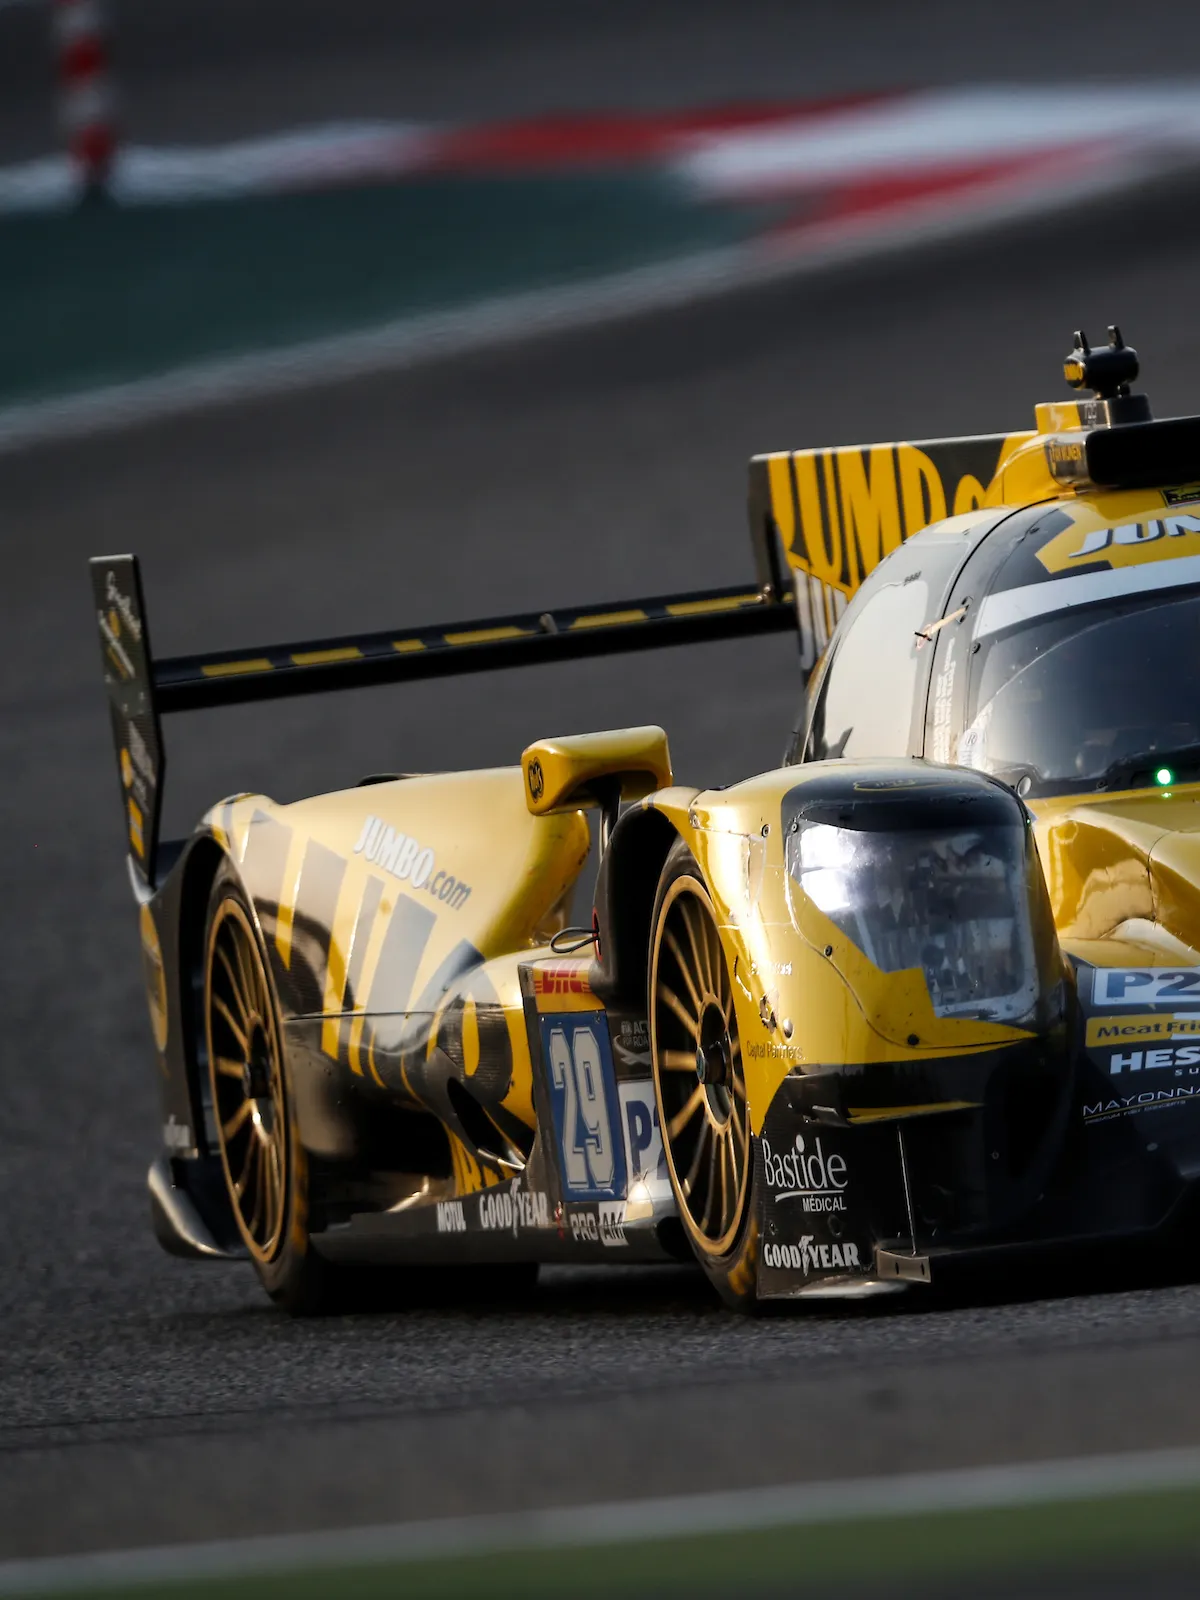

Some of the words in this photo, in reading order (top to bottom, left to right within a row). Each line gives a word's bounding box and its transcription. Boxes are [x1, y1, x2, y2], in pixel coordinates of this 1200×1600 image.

[354, 814, 472, 910] JUMBO.com
[549, 1026, 616, 1189] 29
[762, 1135, 848, 1189] Bastide
[437, 1201, 466, 1232] MOTUL
[480, 1186, 549, 1232] GOODYEAR
[803, 1195, 847, 1212] MÉDICAL
[570, 1212, 599, 1241] PRO
[602, 1211, 625, 1240] AM
[764, 1239, 860, 1271] GOODYEAR
